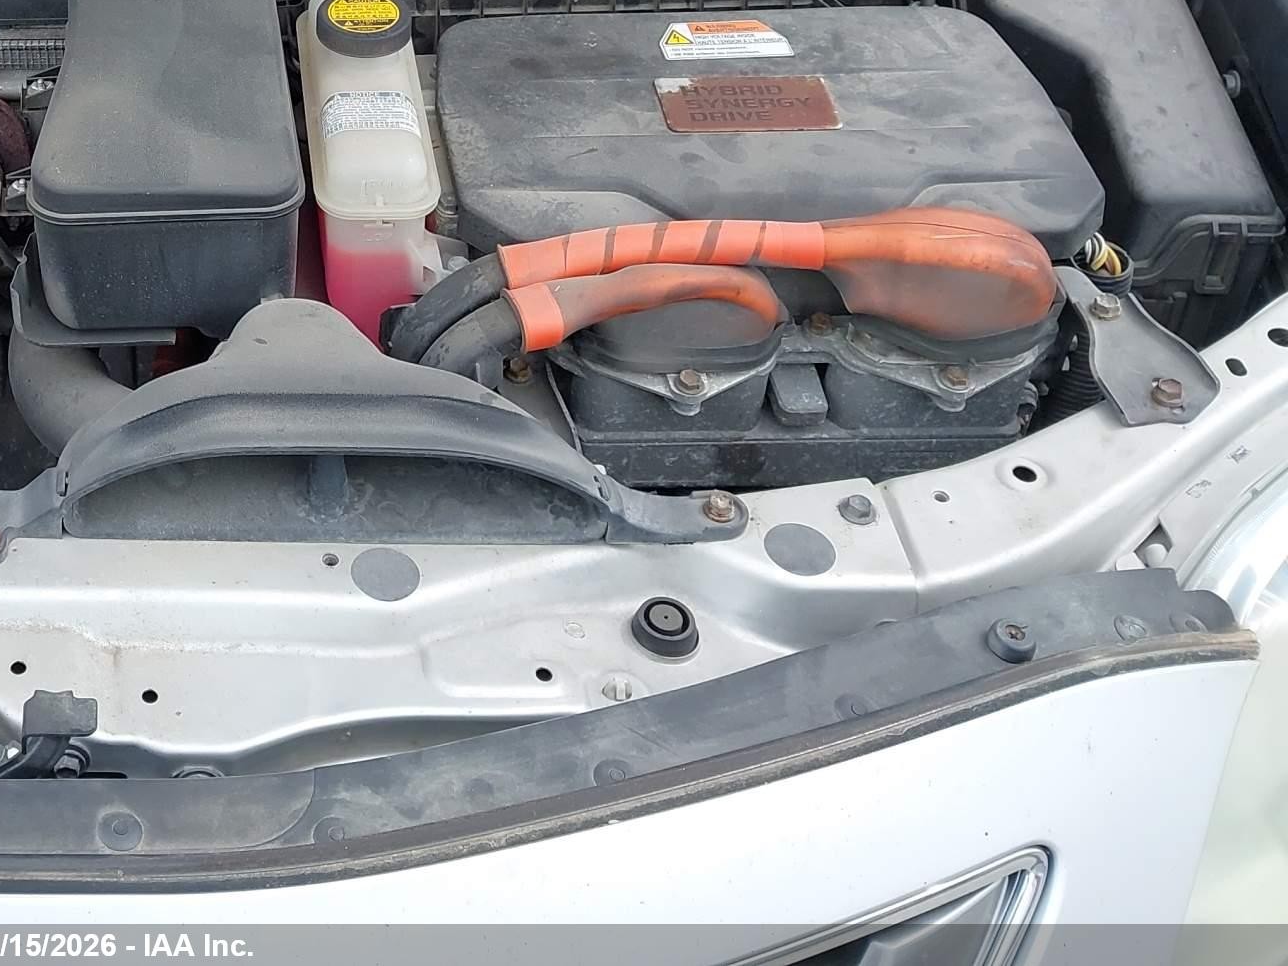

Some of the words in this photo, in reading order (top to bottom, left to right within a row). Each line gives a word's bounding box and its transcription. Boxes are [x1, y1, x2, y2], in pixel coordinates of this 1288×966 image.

[680, 86, 782, 97] HYBRID
[685, 97, 810, 111] SYNERGY
[690, 111, 775, 123] DRIVE
